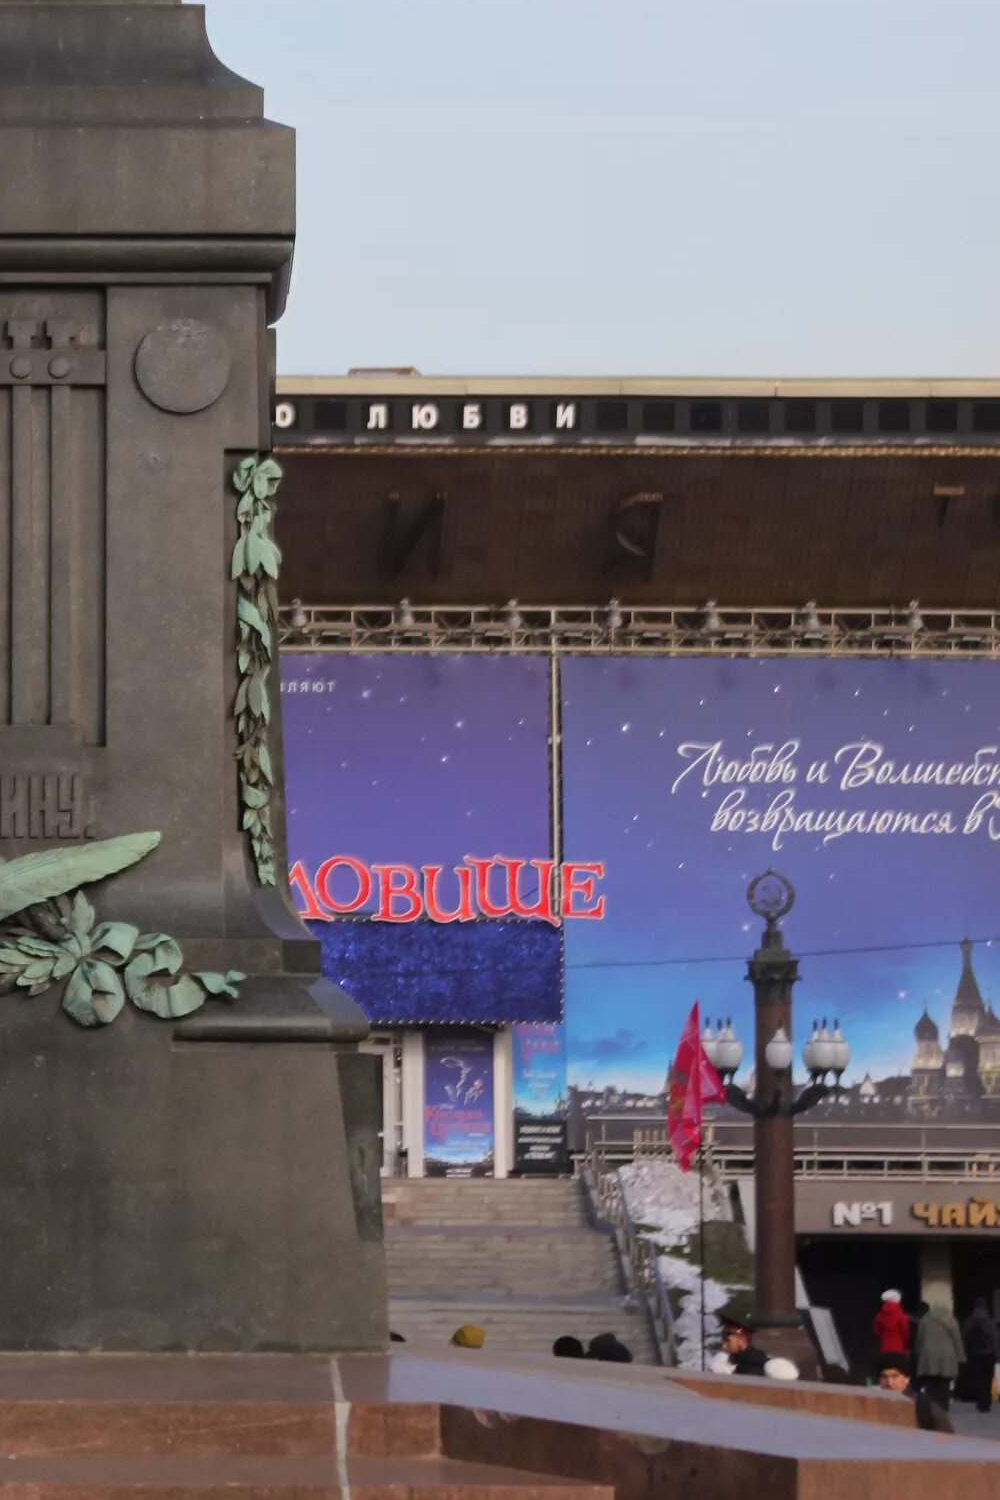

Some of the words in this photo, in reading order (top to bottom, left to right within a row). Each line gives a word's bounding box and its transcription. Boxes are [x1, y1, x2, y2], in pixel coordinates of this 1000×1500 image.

[366, 403, 576, 430] ЛЮБВИ
[671, 740, 800, 795] Любовь
[806, 758, 830, 785] и
[710, 790, 956, 852] возвращаются
[832, 1200, 893, 1227] №1
[911, 1195, 1000, 1227] ЧАЙ
